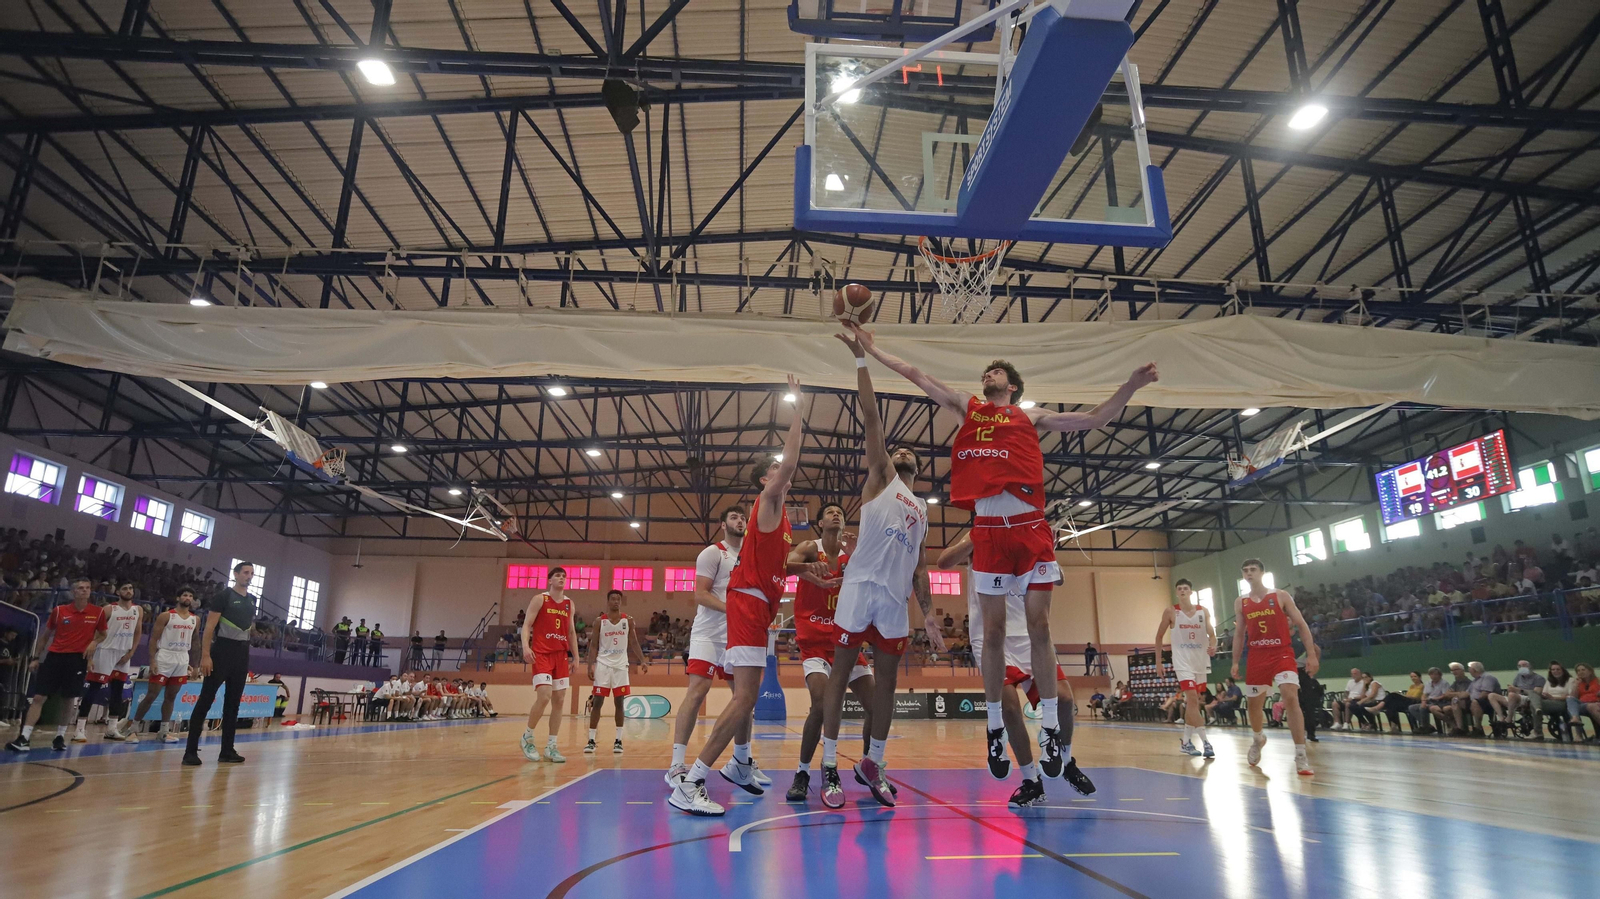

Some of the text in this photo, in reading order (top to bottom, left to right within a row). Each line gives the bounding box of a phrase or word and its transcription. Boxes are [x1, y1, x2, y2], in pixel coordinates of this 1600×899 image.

[976, 426, 995, 441] 12
[957, 448, 1009, 460] endesa
[1465, 486, 1480, 498] 30
[1409, 503, 1422, 514] 19
[905, 514, 917, 530] 17
[1247, 608, 1275, 620] ESPAÑA
[555, 618, 561, 629] 9
[1258, 621, 1267, 633] 5
[1249, 638, 1281, 646] endesa
